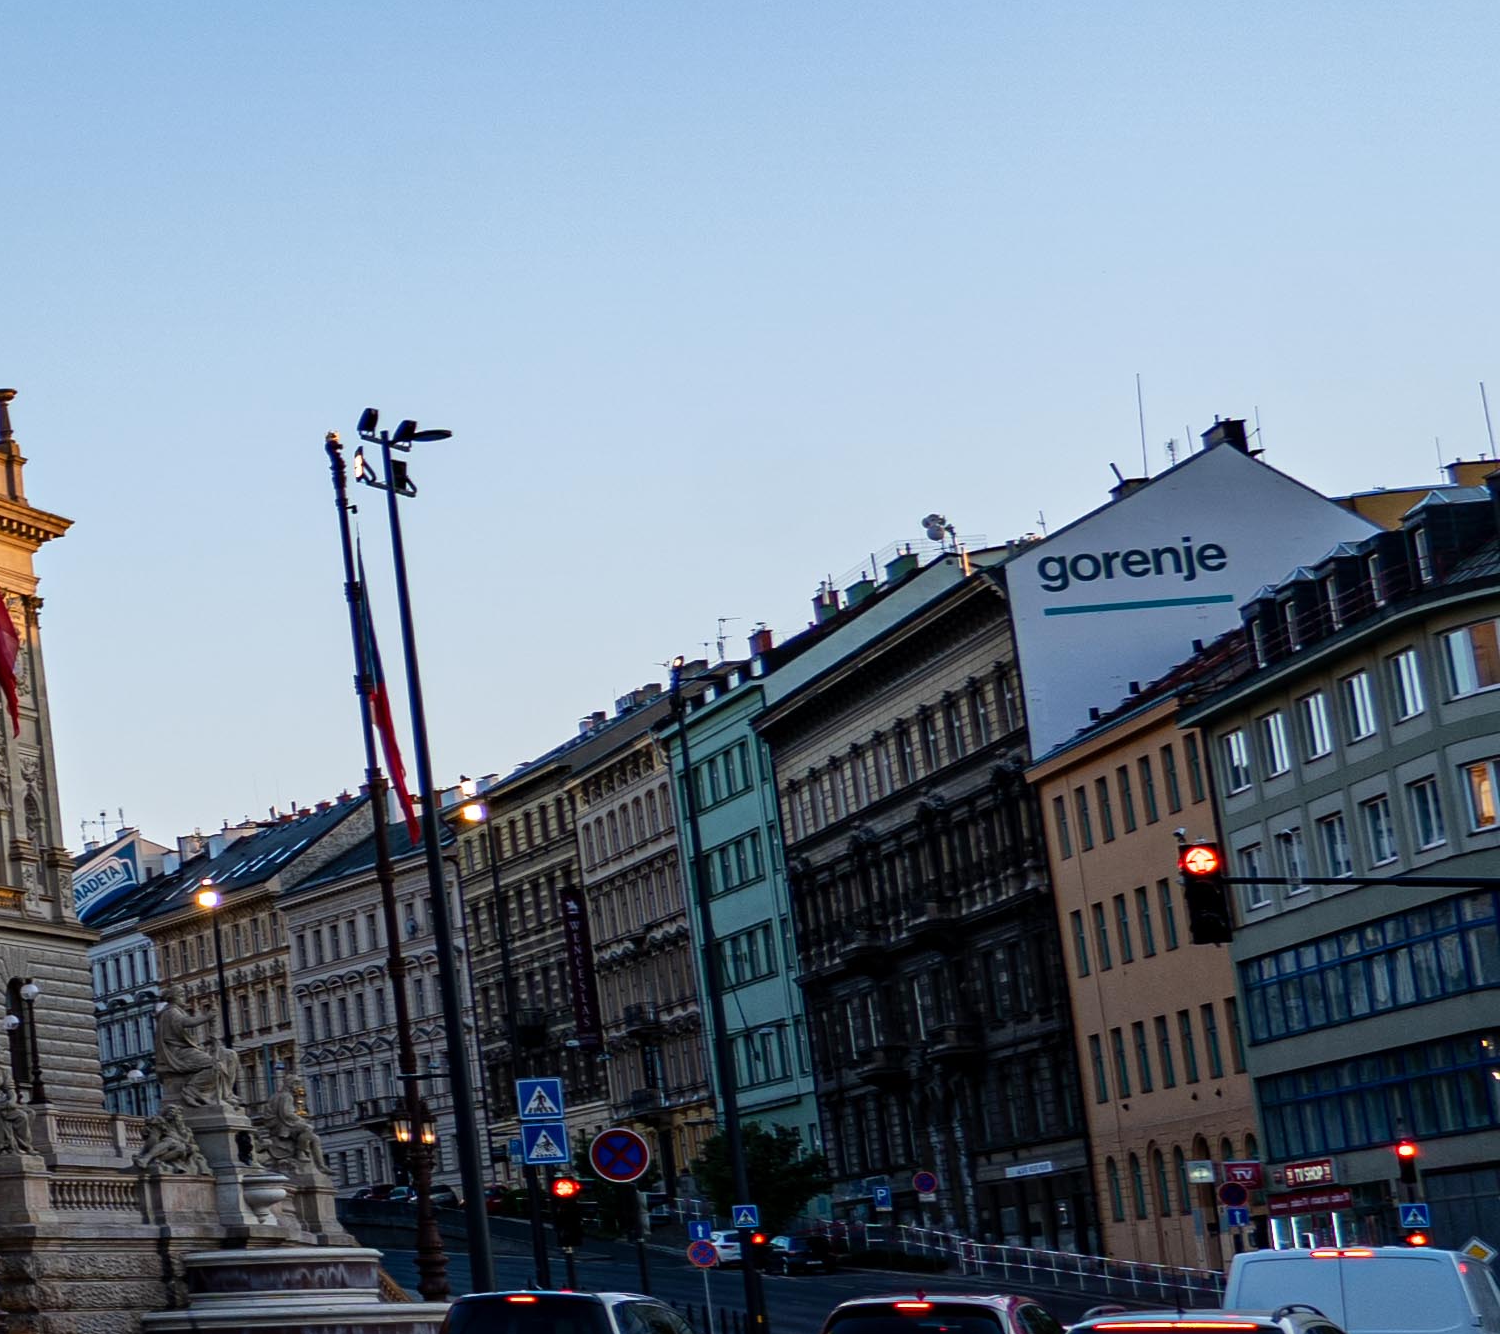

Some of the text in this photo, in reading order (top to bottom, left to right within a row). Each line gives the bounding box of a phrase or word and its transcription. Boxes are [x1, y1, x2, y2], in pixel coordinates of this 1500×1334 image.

[1038, 536, 1227, 592] gorenje
[568, 921, 592, 1028] WENCESLAS
[1232, 1170, 1252, 1180] TV
